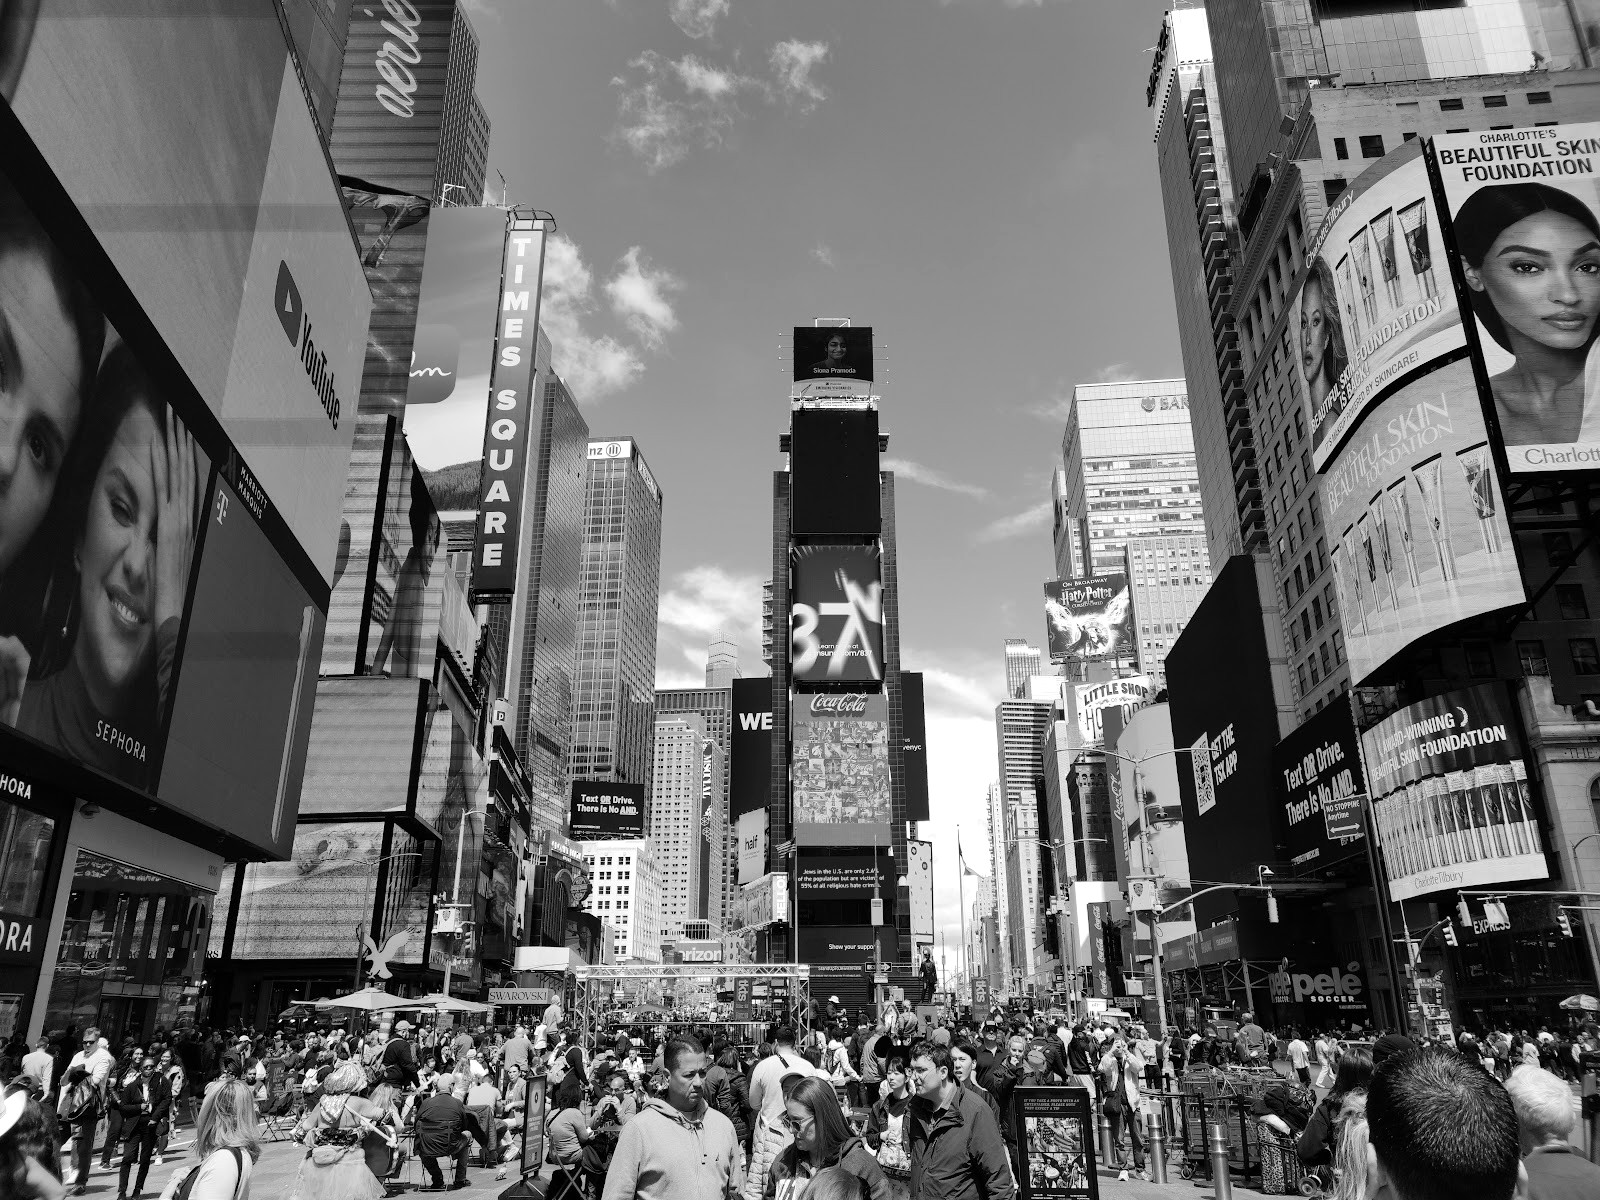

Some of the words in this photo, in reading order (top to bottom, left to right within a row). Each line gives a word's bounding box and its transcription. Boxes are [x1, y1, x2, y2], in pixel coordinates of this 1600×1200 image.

[1480, 129, 1557, 144] CHARLOTTE'S
[1440, 142, 1551, 165] BEAUTIFUL
[1462, 157, 1593, 182] FOUNDATION
[500, 237, 532, 367] TIMES
[1355, 296, 1442, 367] FOUNDATION
[300, 312, 341, 431] YouTube
[1365, 382, 1374, 396] BY
[1374, 350, 1419, 387] SKINCARE!
[1310, 382, 1341, 435] BEAUTIFUL
[1339, 390, 1348, 410] IS
[1327, 433, 1387, 516] BEAUTIFUL
[1387, 392, 1449, 447] SKIN
[1365, 419, 1453, 488] FOUNDATION
[241, 466, 268, 509] MARRIOTT
[482, 389, 517, 567] SQUARE
[238, 480, 263, 519] MARQUIS
[1060, 589, 1086, 606] Harry
[1084, 586, 1113, 602] Potter
[1074, 577, 1108, 587] BROADWAY
[1084, 682, 1119, 707] LITTLE
[1120, 682, 1148, 699] SHOP
[95, 719, 146, 762] SEPHORA
[1221, 722, 1236, 751] THE
[1382, 712, 1456, 755] AWARD-WINNING
[1213, 759, 1227, 786] TSX
[1225, 749, 1238, 778] APP
[1284, 762, 1304, 793] Text
[1303, 752, 1318, 786] OR
[1315, 741, 1344, 773] Drive.
[1370, 757, 1401, 783] BEAUTIFUL
[1399, 746, 1420, 766] SKIN
[1420, 724, 1507, 759] FOUNDATION
[577, 803, 599, 813] There
[608, 805, 619, 814] No
[620, 806, 639, 816] AND.
[581, 794, 599, 803] Text
[600, 795, 611, 805] OR
[613, 796, 634, 804] Drive.
[1285, 797, 1310, 827] There
[1308, 790, 1319, 815] Is
[1317, 782, 1332, 810] No
[1331, 768, 1357, 800] AND.
[1325, 805, 1334, 813] NO
[1327, 811, 1350, 822] Anytime
[744, 834, 759, 851] half
[826, 882, 850, 890] religious
[853, 868, 865, 876] only
[776, 875, 788, 920] HELLO!
[489, 991, 548, 1001] SWAROVSKI
[1310, 995, 1355, 1003] SOCCER
